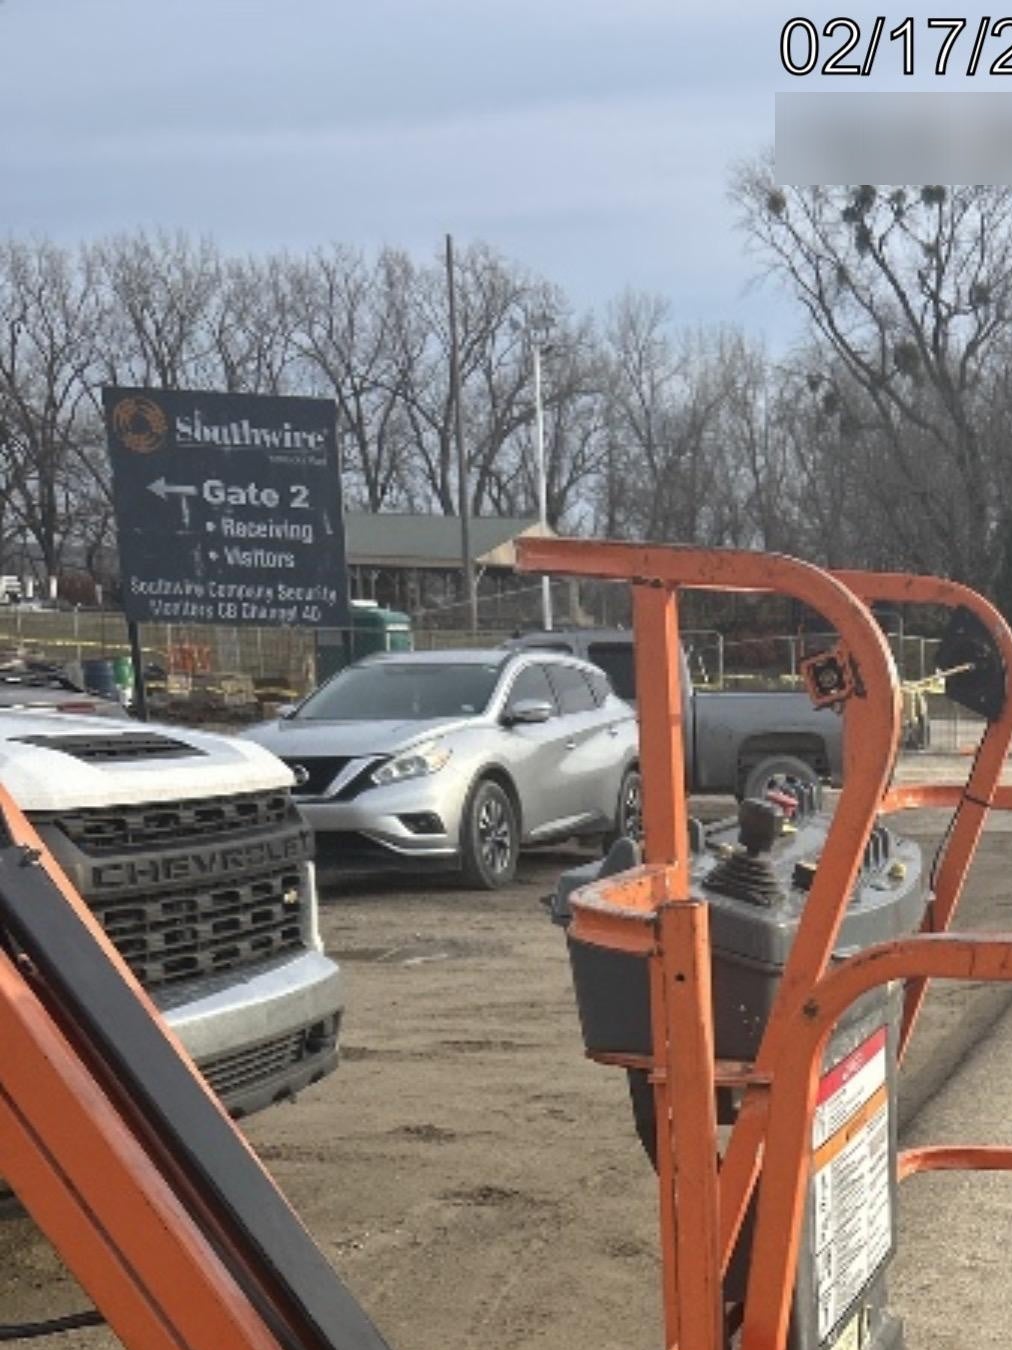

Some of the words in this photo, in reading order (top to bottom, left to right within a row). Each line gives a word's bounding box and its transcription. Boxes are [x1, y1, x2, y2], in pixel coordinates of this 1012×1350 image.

[203, 479, 280, 508] Gate
[290, 484, 310, 508] 2
[221, 517, 313, 544] Receiving
[223, 545, 295, 569] Visitors
[91, 831, 309, 888] CHEVROLET
